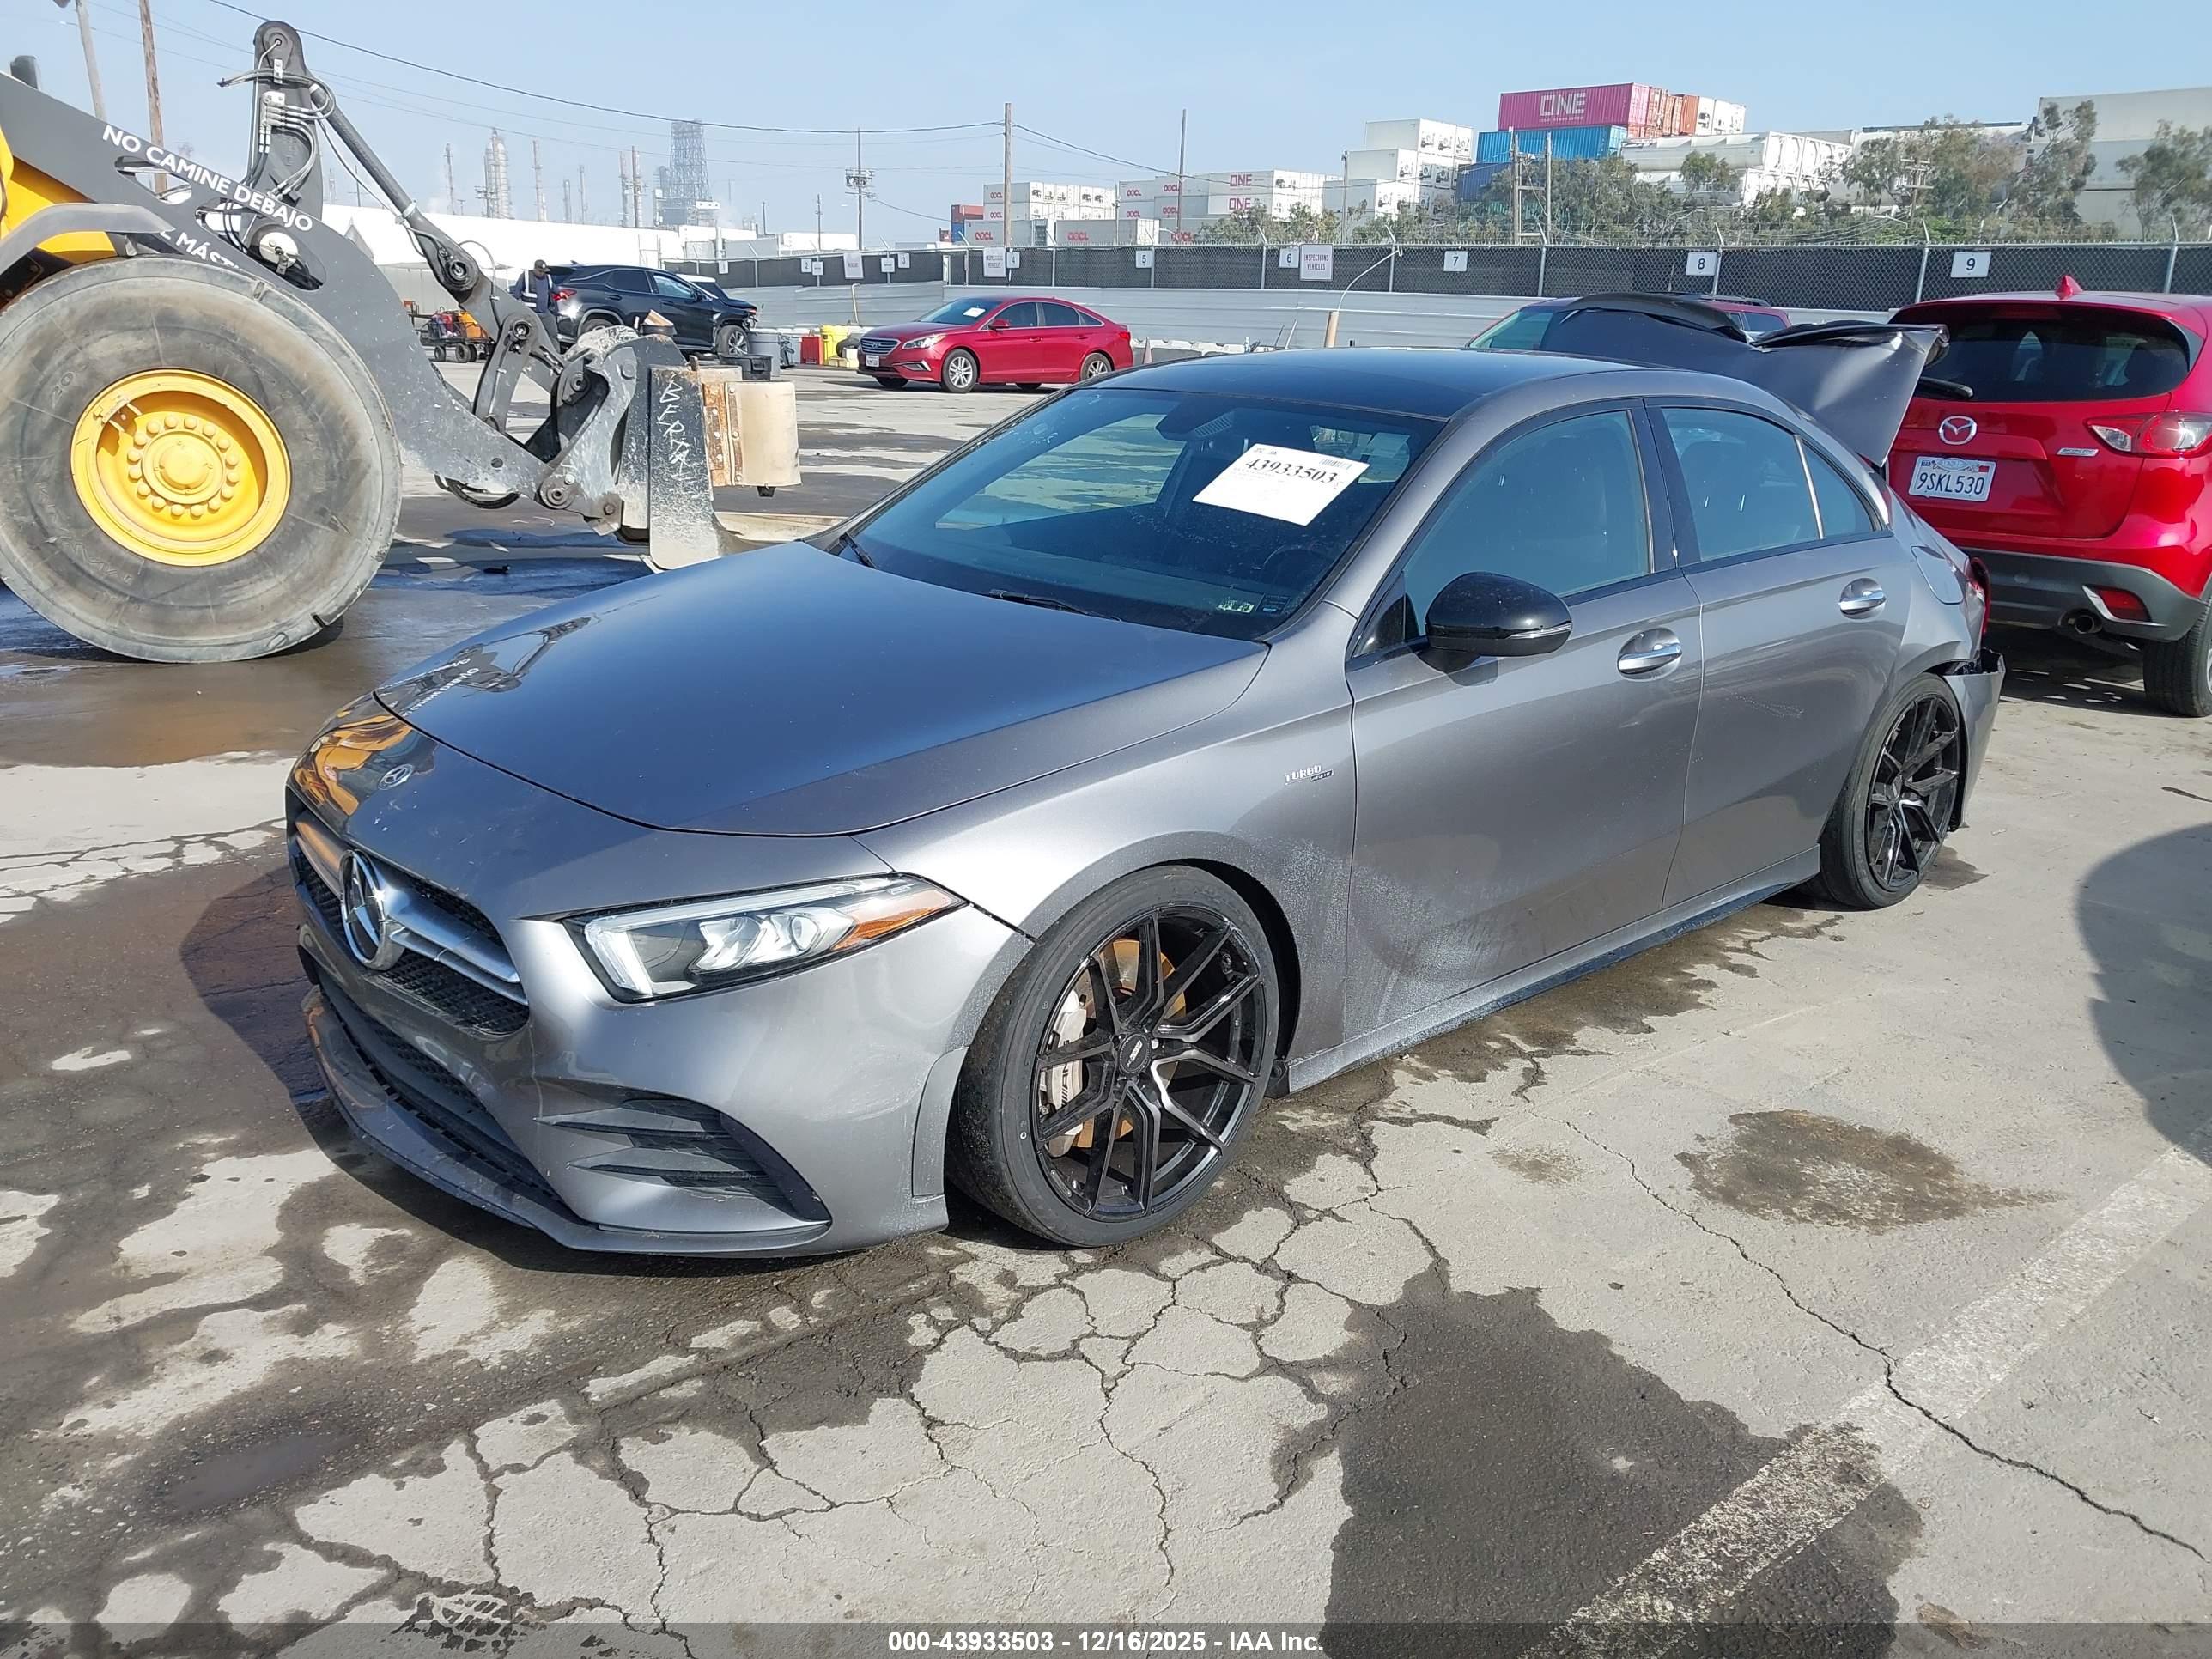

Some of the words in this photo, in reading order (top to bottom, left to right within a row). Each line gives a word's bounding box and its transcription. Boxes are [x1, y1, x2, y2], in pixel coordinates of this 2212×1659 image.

[1540, 93, 1586, 116] ONE
[102, 125, 141, 153] NO
[146, 145, 231, 195] CAMINE
[233, 185, 313, 231] DEBAJO
[1230, 174, 1252, 187] ONE
[1229, 198, 1251, 210] ONE
[975, 232, 994, 240] OOCL
[1067, 232, 1090, 241] OOCL
[1142, 254, 1146, 264] 5
[1286, 253, 1292, 263] 6
[1453, 256, 1459, 266] 7
[1698, 258, 1705, 270] 8
[1966, 258, 1976, 271] 9
[1245, 458, 1339, 484] 43933503
[1916, 472, 1985, 495] 9SKL530
[1285, 764, 1322, 782] TURBO
